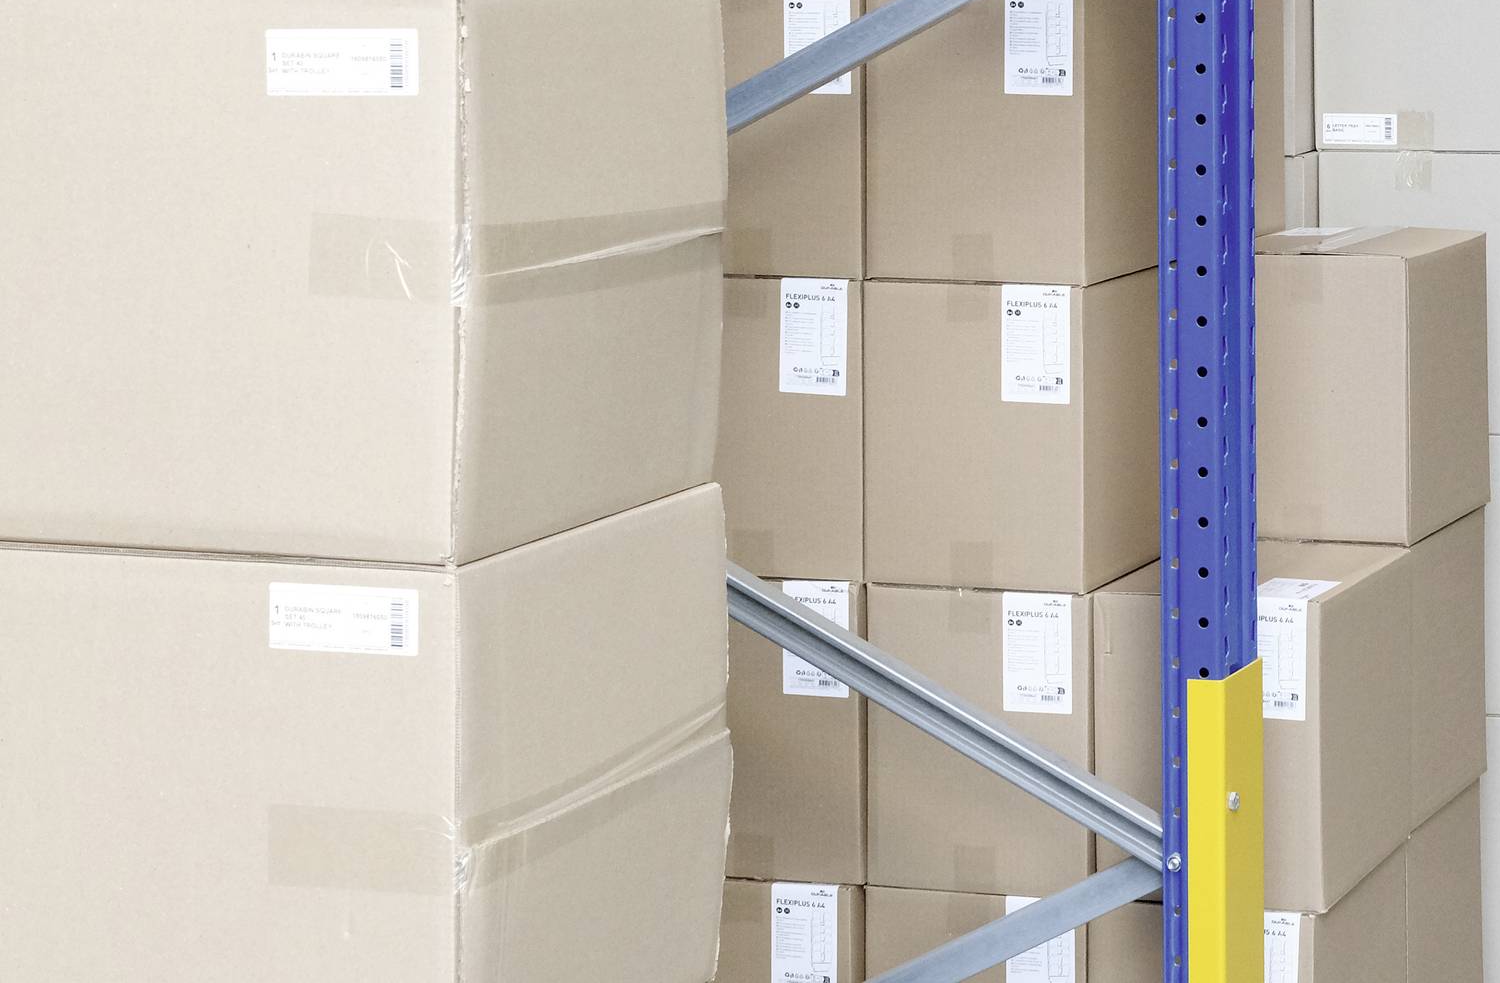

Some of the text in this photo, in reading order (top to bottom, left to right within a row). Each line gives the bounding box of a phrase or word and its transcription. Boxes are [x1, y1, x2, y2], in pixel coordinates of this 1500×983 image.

[785, 293, 821, 302] FLEXIPLUS
[1006, 300, 1042, 308] FLEXIPLUS
[793, 596, 821, 604] EXIPLUS
[1007, 610, 1043, 618] FLEXIPLUS
[776, 898, 811, 908] FLEXIPLUS
